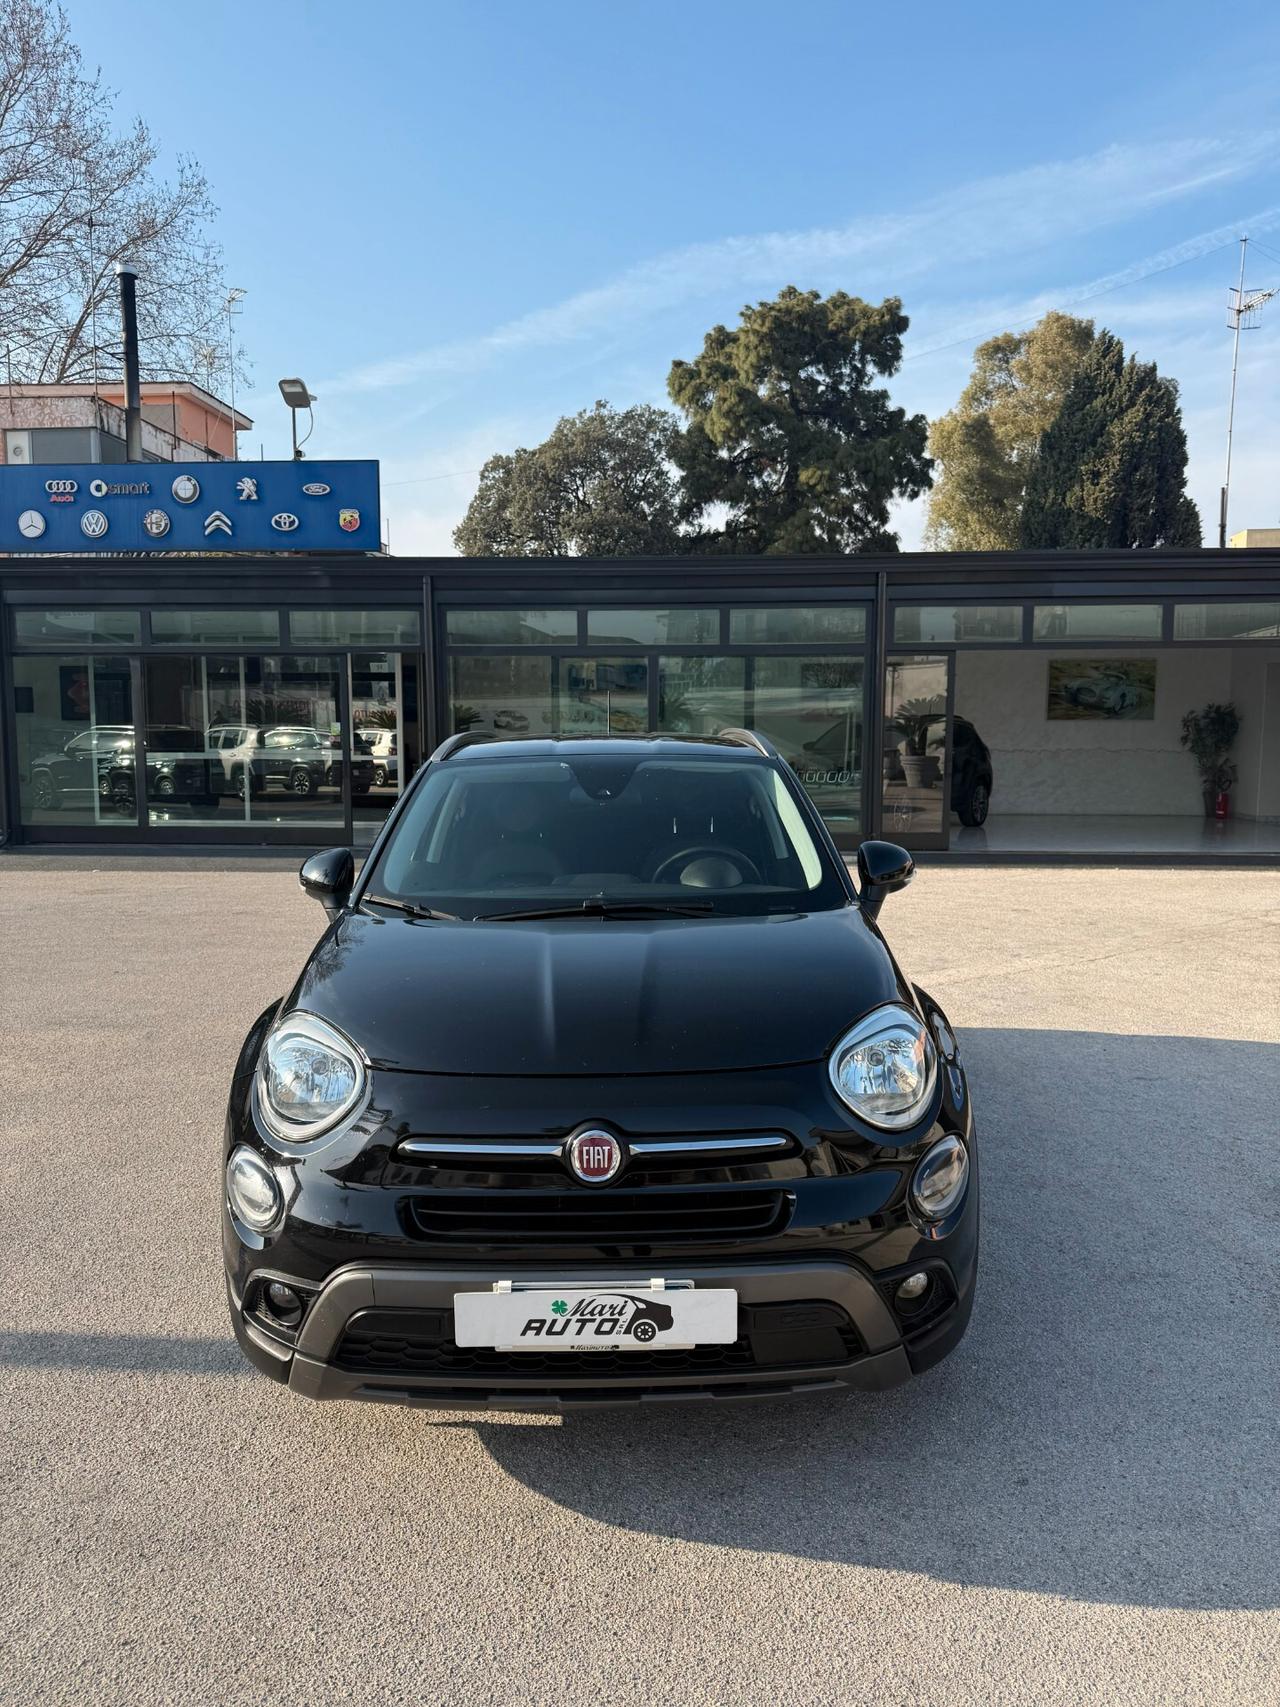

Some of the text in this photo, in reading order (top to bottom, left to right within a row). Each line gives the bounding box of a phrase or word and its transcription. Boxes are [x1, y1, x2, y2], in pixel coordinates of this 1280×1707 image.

[107, 481, 150, 494] smart
[582, 1146, 611, 1169] FIAT
[563, 1298, 629, 1317] Mari
[520, 1318, 620, 1337] AUTO
